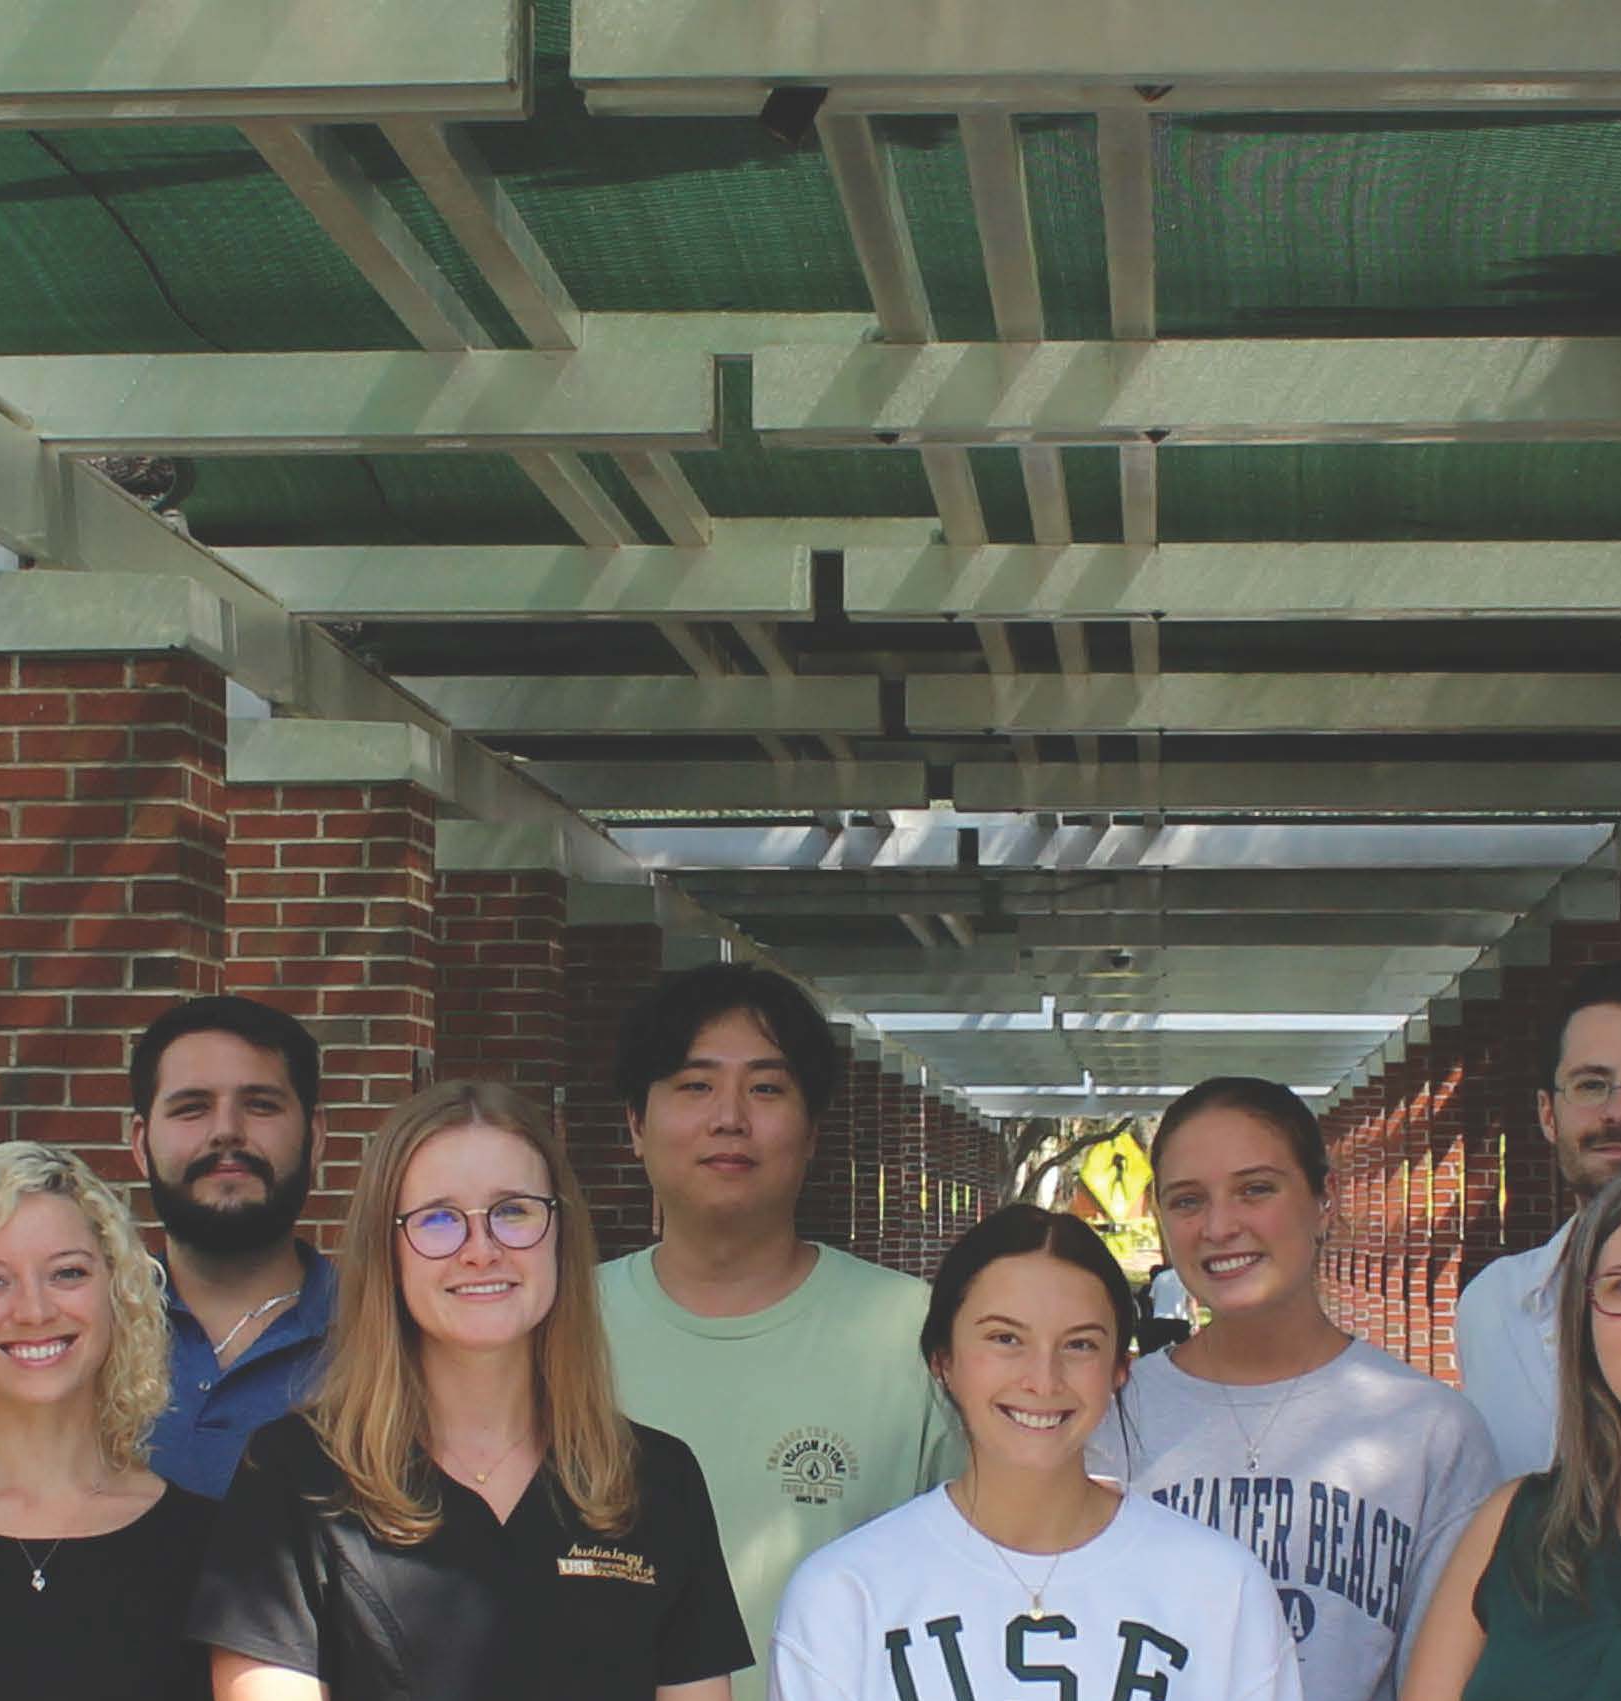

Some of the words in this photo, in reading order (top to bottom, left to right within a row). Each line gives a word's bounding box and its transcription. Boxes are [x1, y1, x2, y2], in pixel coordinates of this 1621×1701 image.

[782, 1440, 819, 1467] VOLCOM
[822, 1443, 846, 1473] STONE
[1304, 1481, 1412, 1634] BEACH
